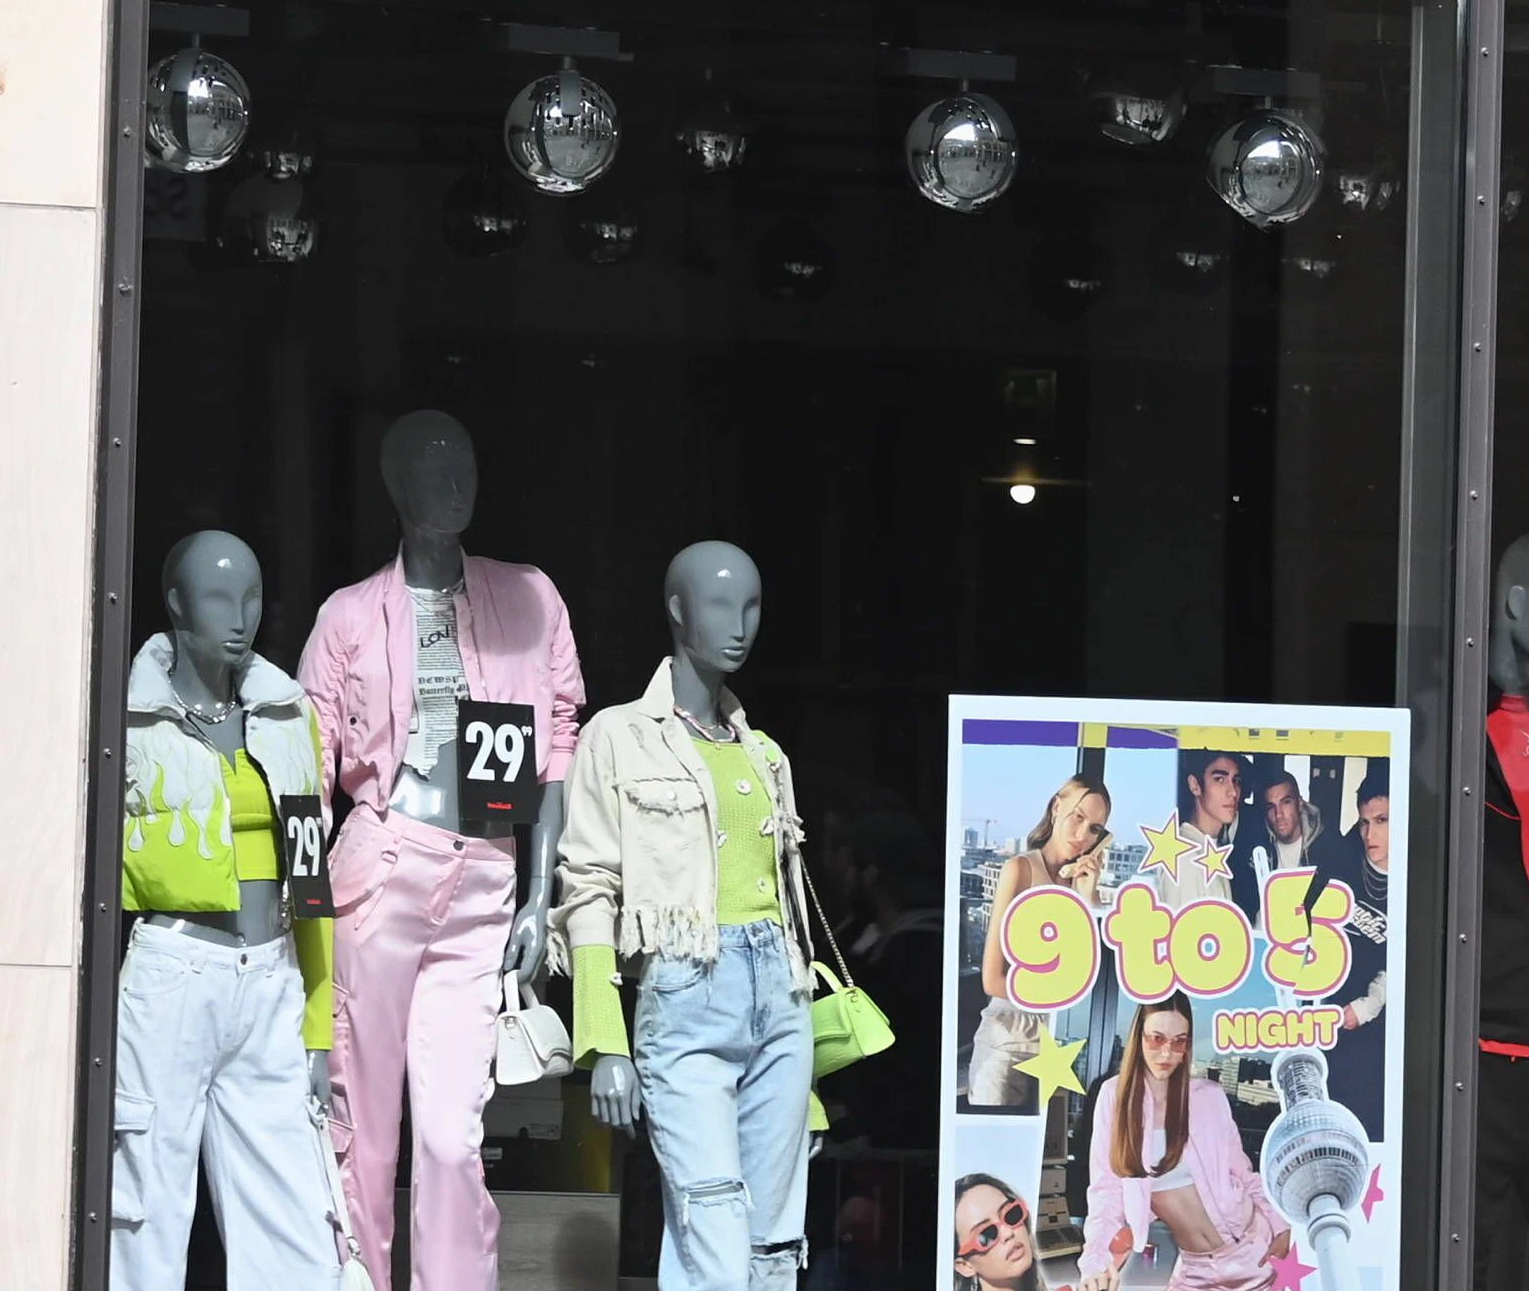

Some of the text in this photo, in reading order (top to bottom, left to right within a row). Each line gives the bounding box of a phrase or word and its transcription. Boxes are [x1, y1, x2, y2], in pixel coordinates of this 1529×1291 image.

[1002, 870, 1354, 1010] 9 to 5
[1215, 1009, 1341, 1051] NIGHT
